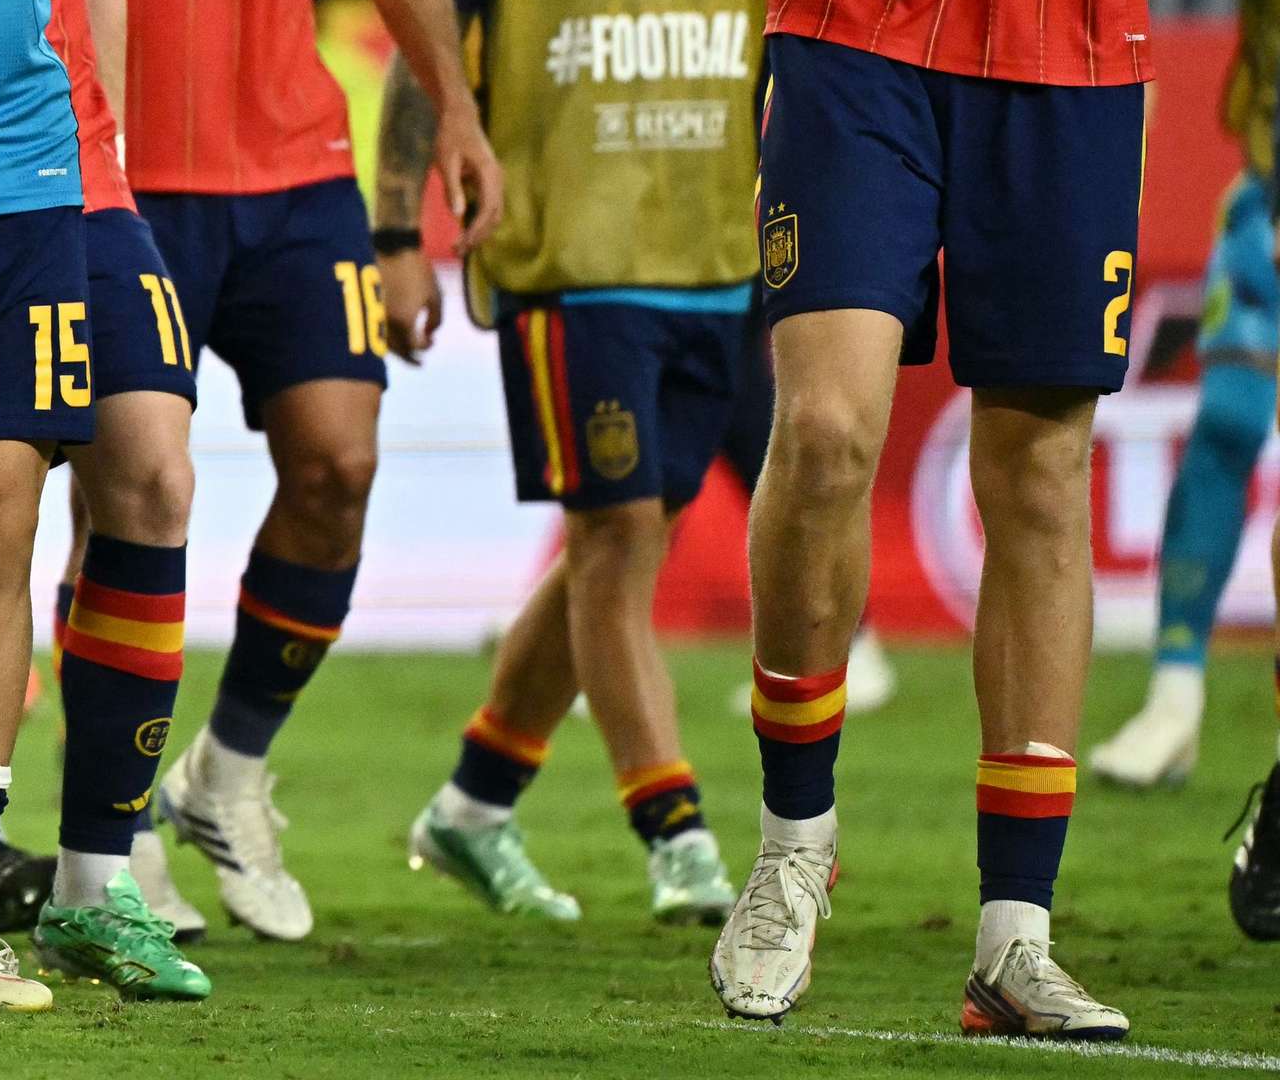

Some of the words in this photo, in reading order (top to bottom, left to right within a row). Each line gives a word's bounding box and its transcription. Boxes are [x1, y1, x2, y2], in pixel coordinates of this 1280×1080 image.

[29, 302, 92, 410] 15
[139, 274, 192, 372] 11
[1103, 250, 1133, 357] 2
